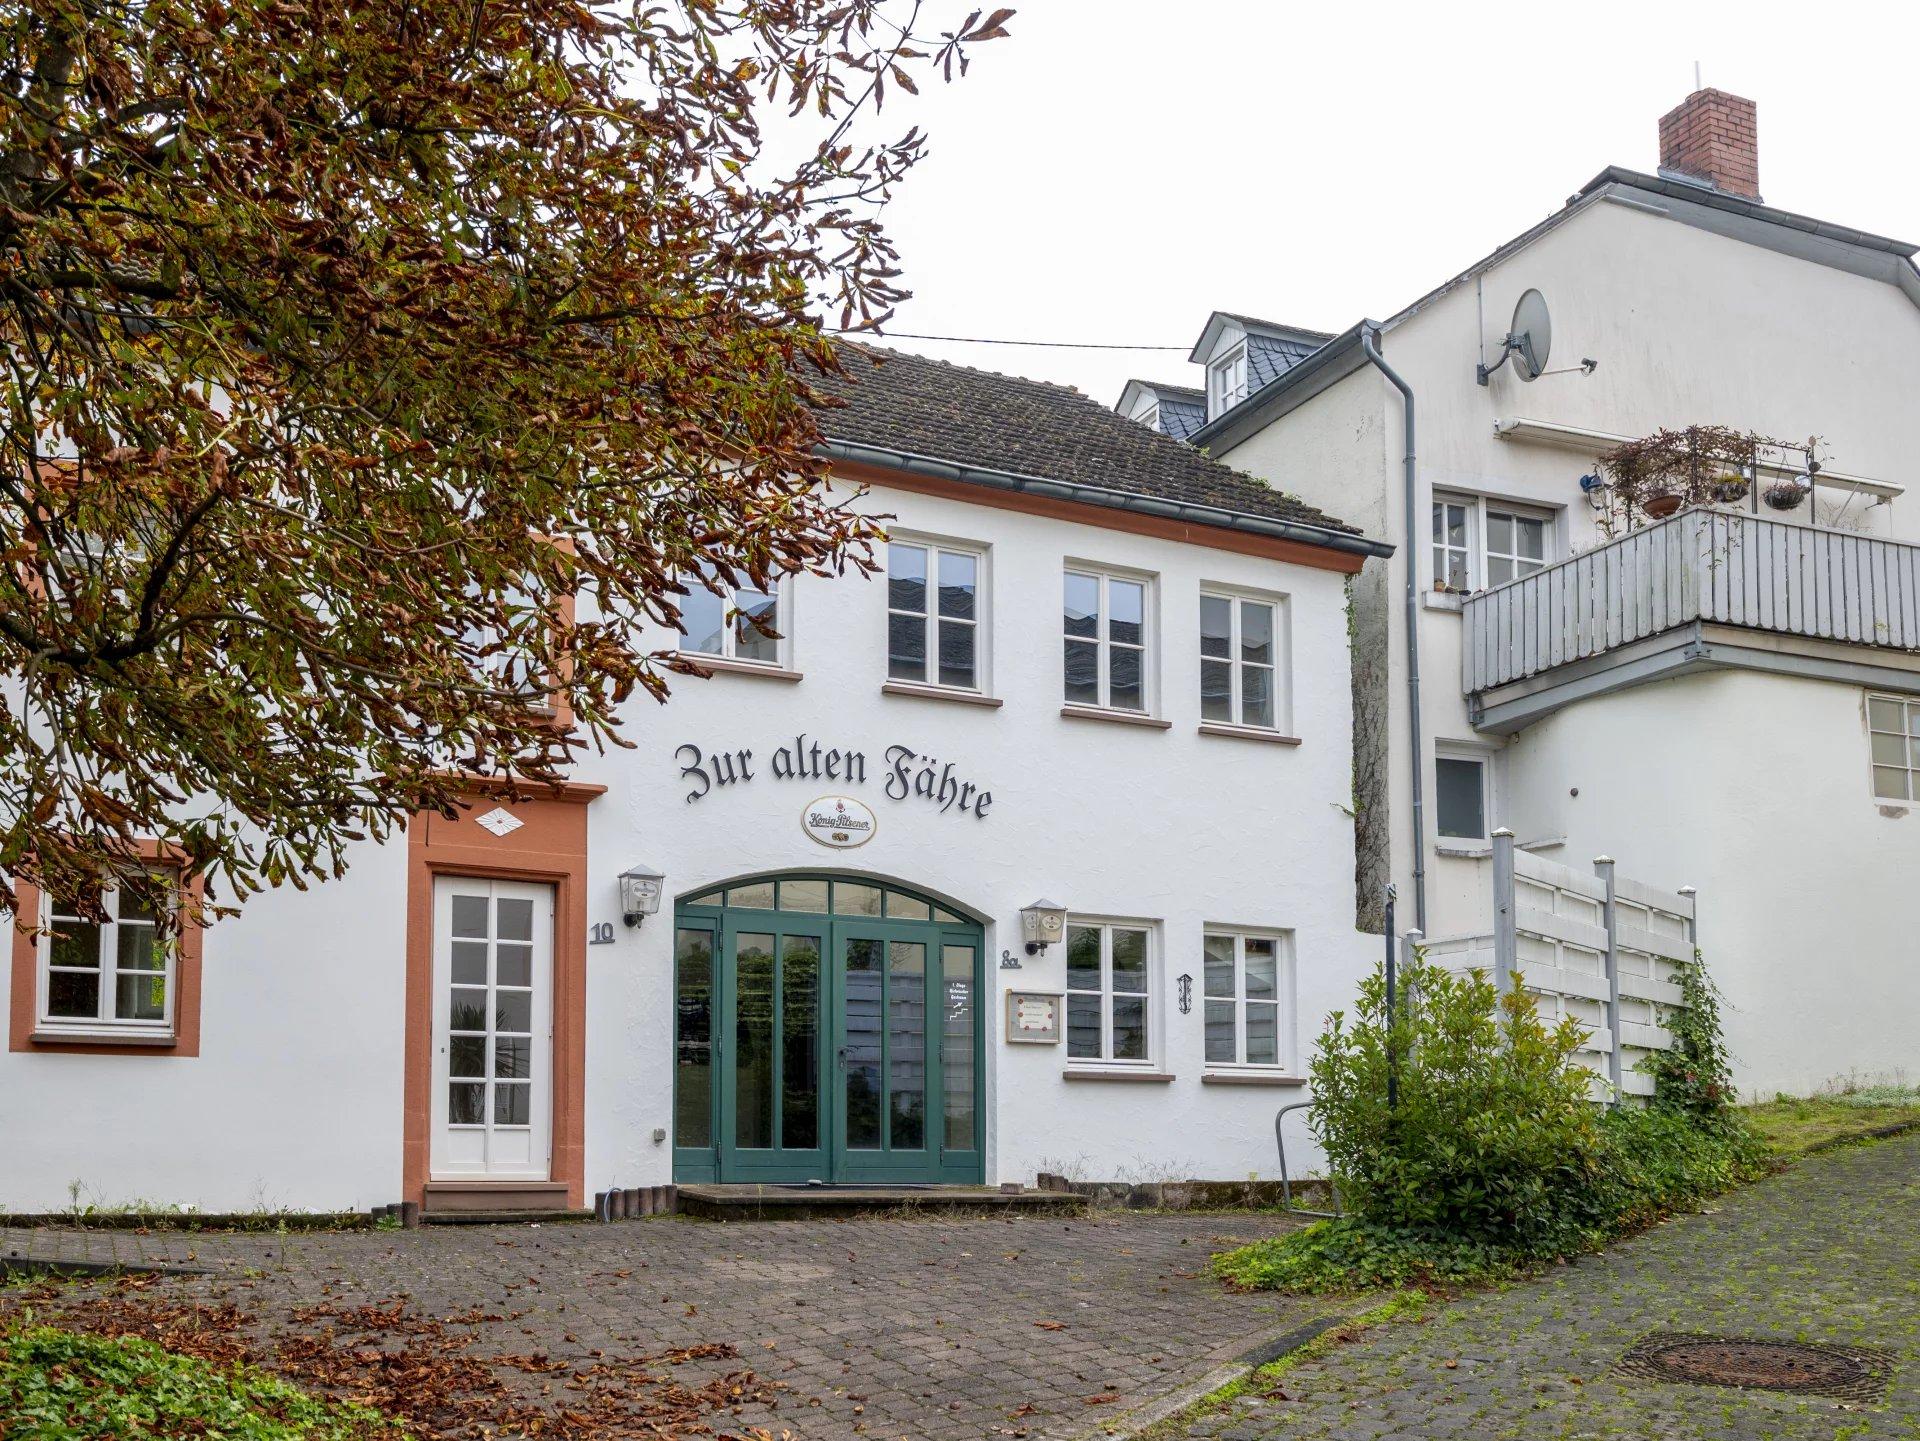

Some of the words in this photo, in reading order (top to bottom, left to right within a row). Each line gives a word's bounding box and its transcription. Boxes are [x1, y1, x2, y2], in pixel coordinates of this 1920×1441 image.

[675, 743, 755, 804] Zur
[772, 733, 867, 783] alten
[885, 744, 993, 819] Fähre
[589, 922, 614, 941] 10
